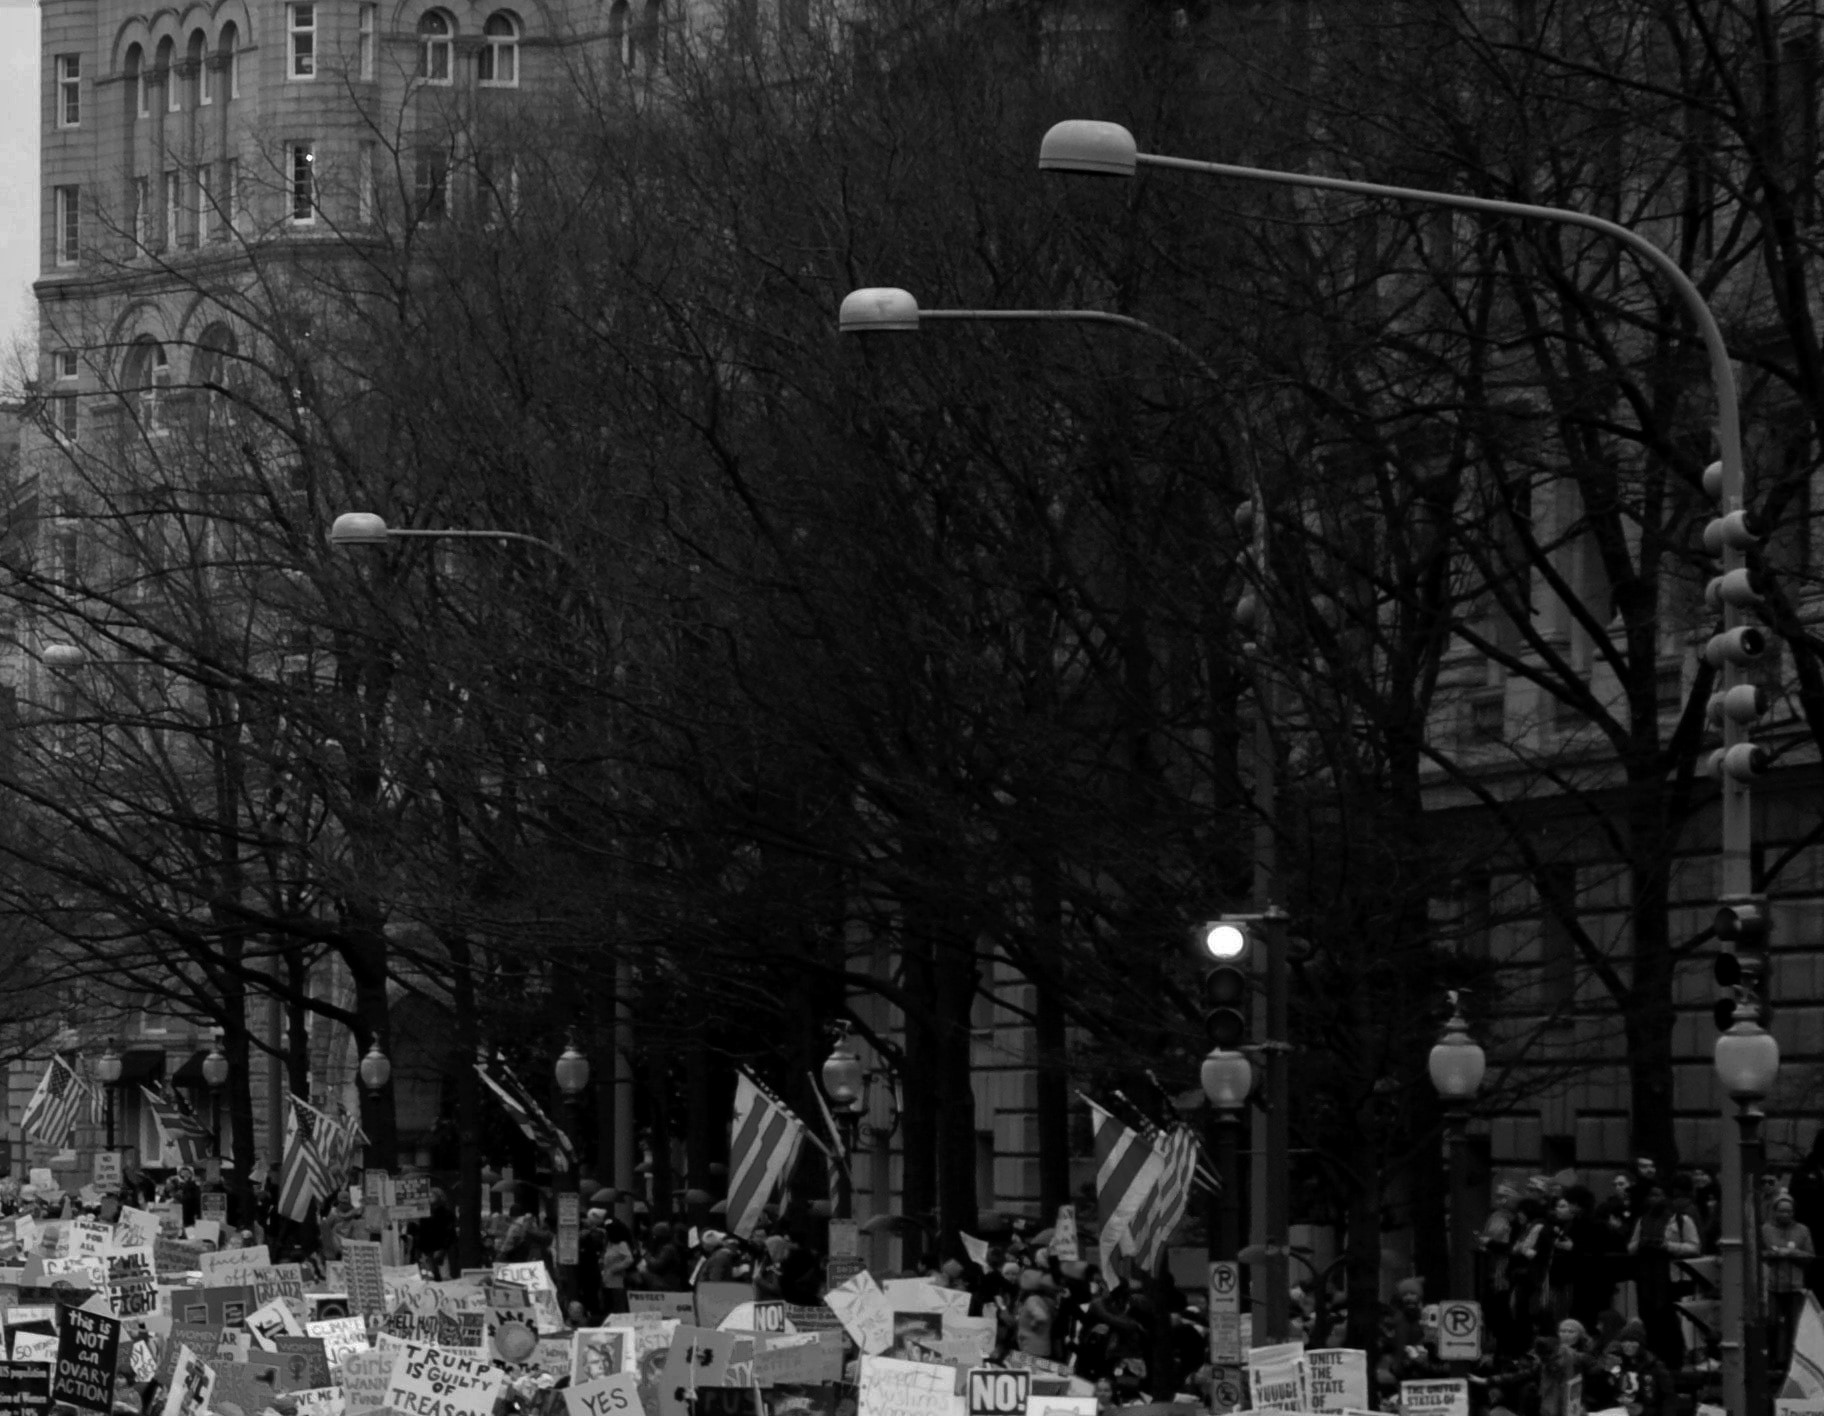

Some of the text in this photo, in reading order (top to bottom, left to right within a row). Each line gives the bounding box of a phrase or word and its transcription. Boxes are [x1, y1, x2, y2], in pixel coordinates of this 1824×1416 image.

[69, 1310, 111, 1333] this is
[75, 1332, 107, 1349] NOT
[79, 1351, 100, 1364] an
[406, 1343, 491, 1375] TRUMP
[59, 1362, 109, 1387] OVARY
[406, 1362, 493, 1391] IS GUILTY
[56, 1378, 109, 1402] ACTION
[432, 1381, 456, 1394] OF
[973, 1375, 1026, 1408] NO!
